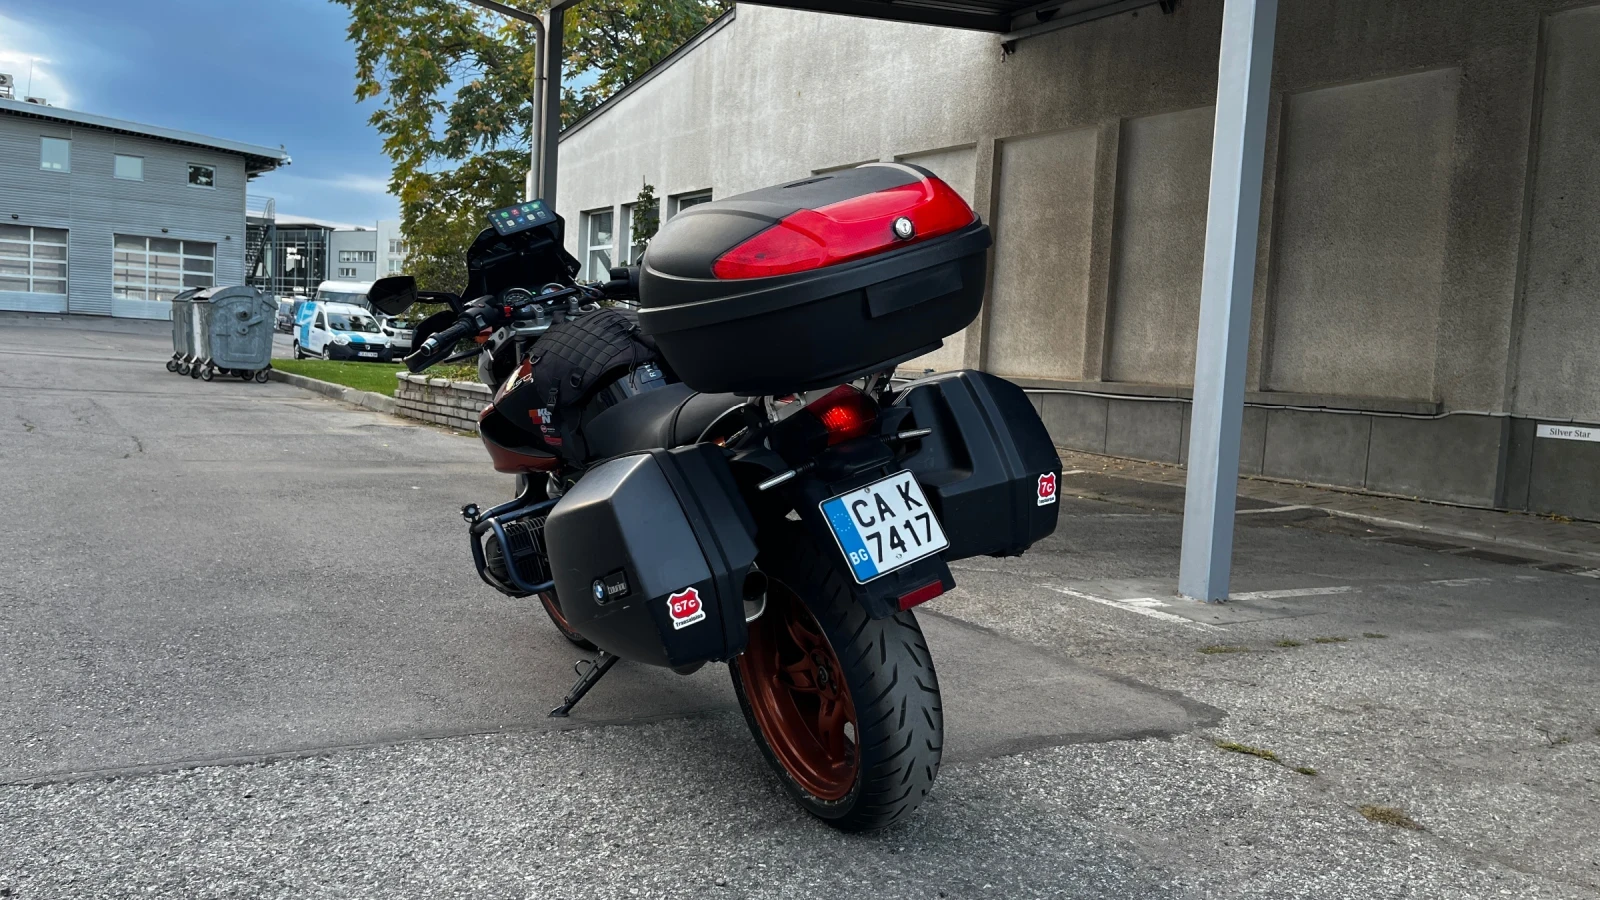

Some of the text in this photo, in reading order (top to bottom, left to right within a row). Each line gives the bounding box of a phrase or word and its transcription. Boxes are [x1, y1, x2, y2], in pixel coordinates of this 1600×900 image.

[1550, 428, 1591, 438] Silver Star
[851, 480, 923, 528] CA K
[865, 512, 932, 563] 7417
[849, 548, 869, 565] BG
[674, 599, 696, 613] 67c
